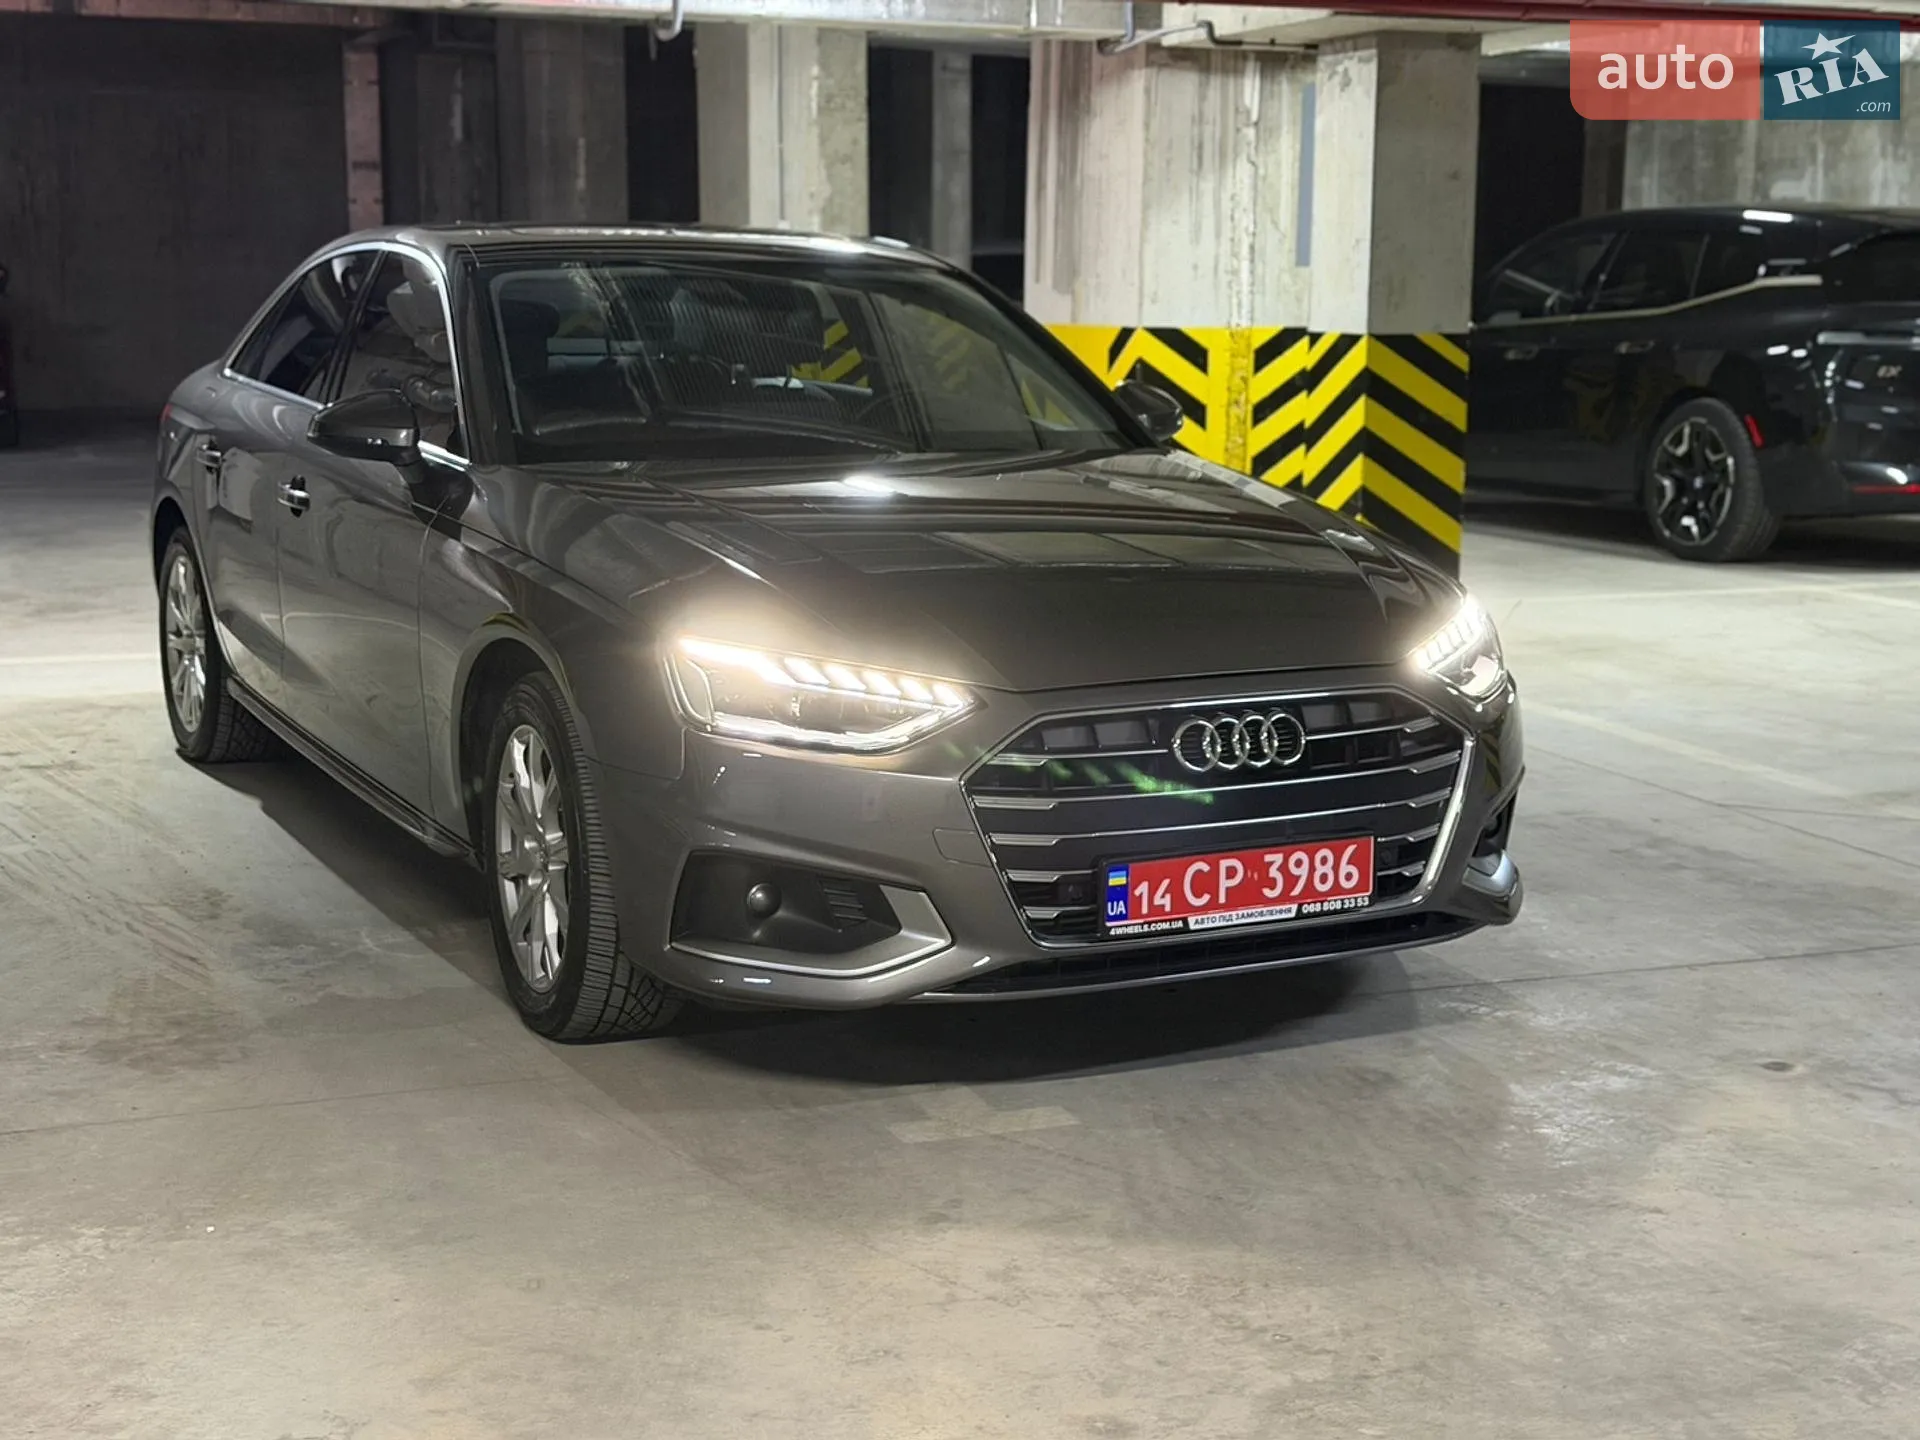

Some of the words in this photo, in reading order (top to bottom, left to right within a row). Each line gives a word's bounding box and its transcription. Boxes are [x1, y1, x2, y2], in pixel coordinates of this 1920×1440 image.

[1133, 878, 1171, 915] 14
[1183, 858, 1244, 907] CP
[1262, 844, 1360, 899] 3986
[1107, 900, 1127, 916] UA
[1343, 898, 1356, 909] 33
[1193, 916, 1217, 926] АВТО
[1235, 906, 1293, 921] ЗАМОВЛЕННЯ
[1109, 919, 1184, 936] 4WHEELS.COM.UA
